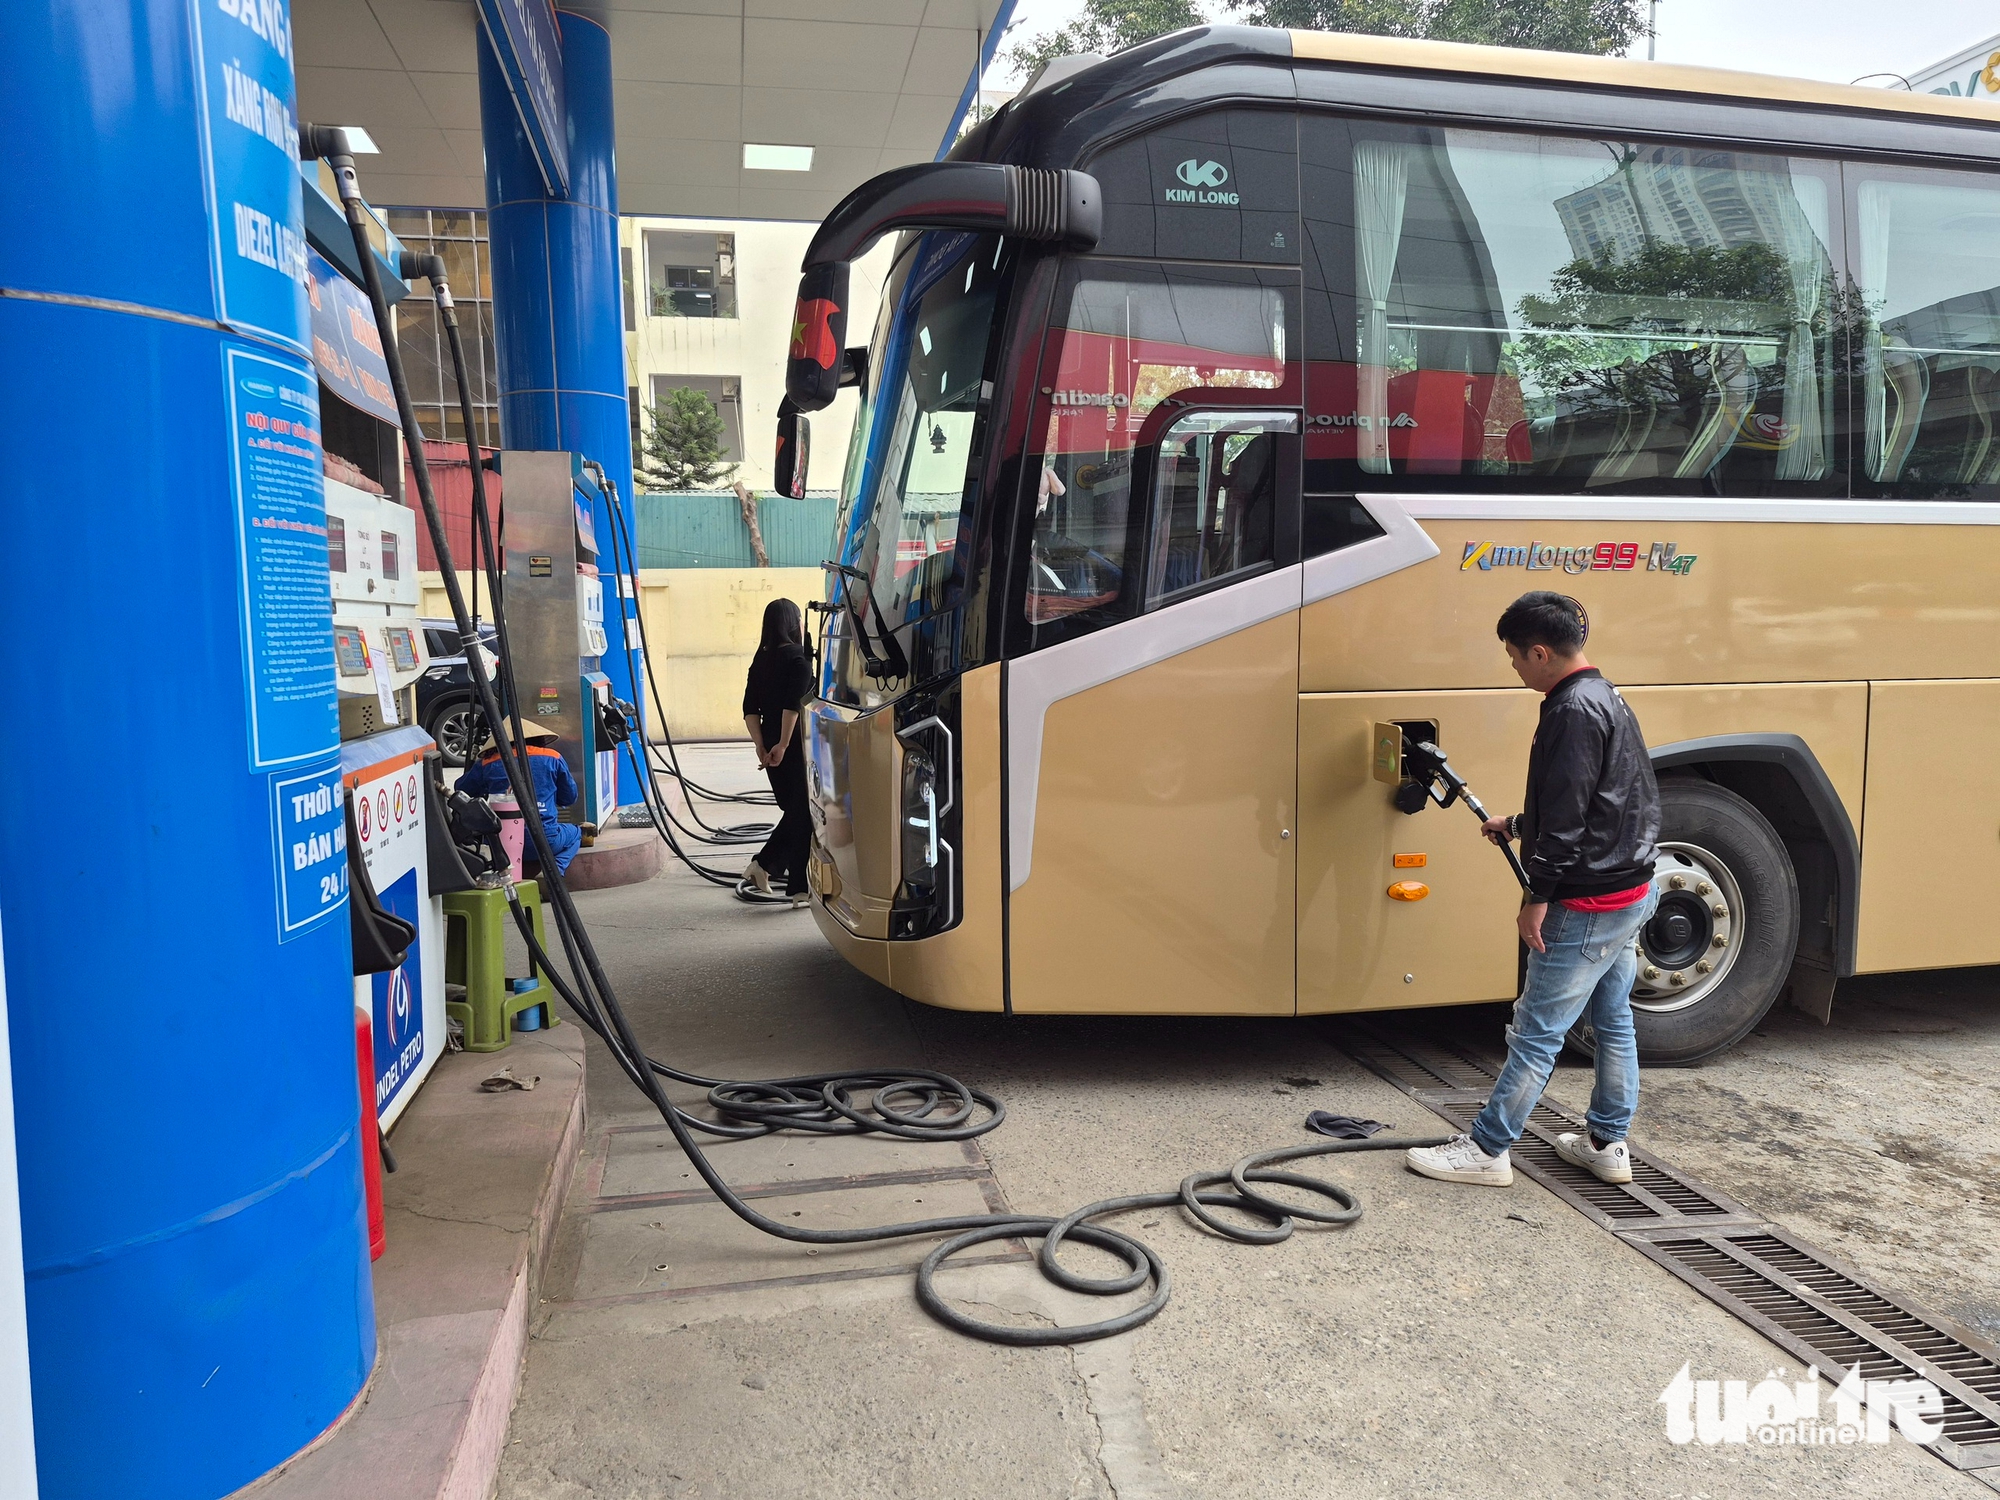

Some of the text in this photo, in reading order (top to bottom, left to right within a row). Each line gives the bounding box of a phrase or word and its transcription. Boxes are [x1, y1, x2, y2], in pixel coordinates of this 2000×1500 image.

[222, 58, 264, 137] XĂNG
[1166, 189, 1240, 205] KIM LONG
[233, 202, 279, 270] DIEZEL
[292, 783, 332, 823] THỜI
[293, 832, 332, 871] BÁN
[1697, 817, 1776, 957] BRIDGESTONE
[400, 1030, 422, 1076] PETRO
